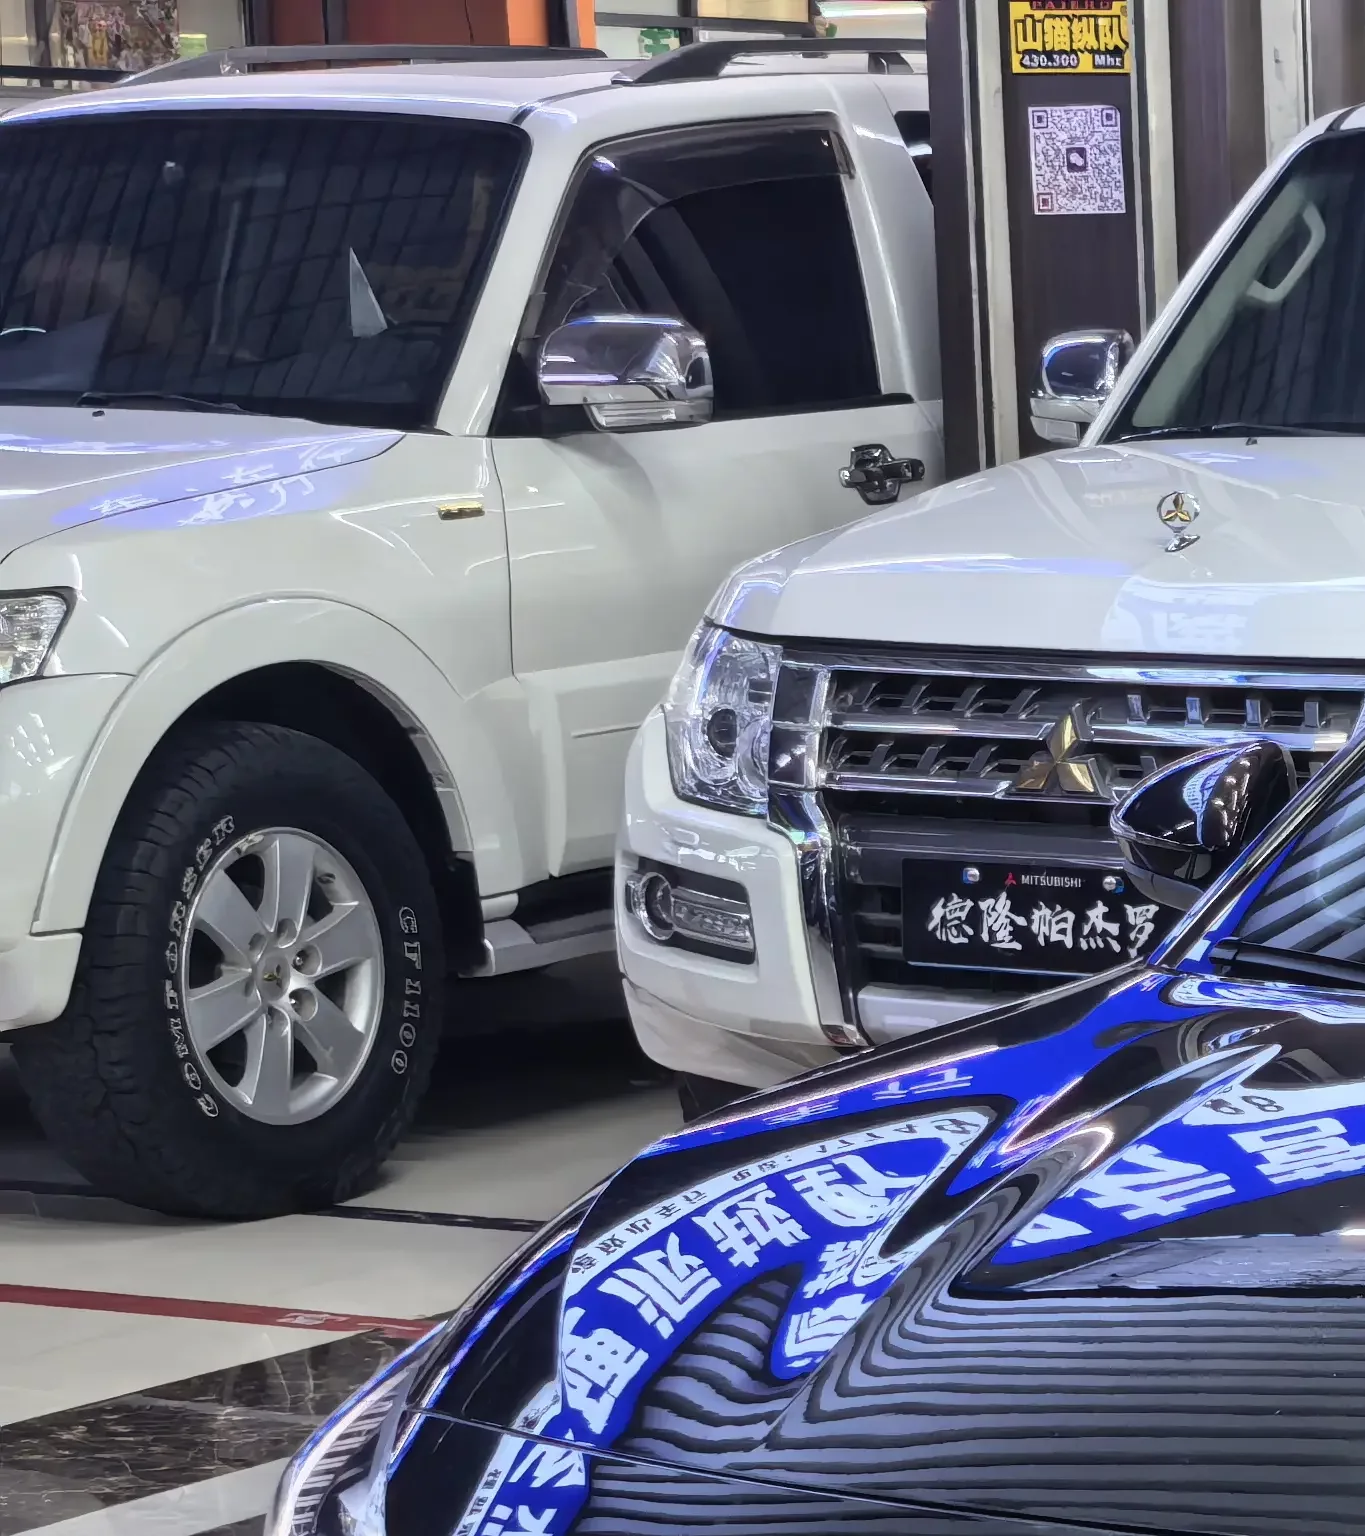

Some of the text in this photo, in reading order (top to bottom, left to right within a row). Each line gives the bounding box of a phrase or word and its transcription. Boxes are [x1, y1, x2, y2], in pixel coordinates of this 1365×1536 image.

[1015, 14, 1127, 53] 山猫纵队
[1021, 54, 1079, 67] 430.300
[1021, 873, 1083, 889] MITSUBISHI
[927, 892, 1161, 959] 德隆帕杰罗
